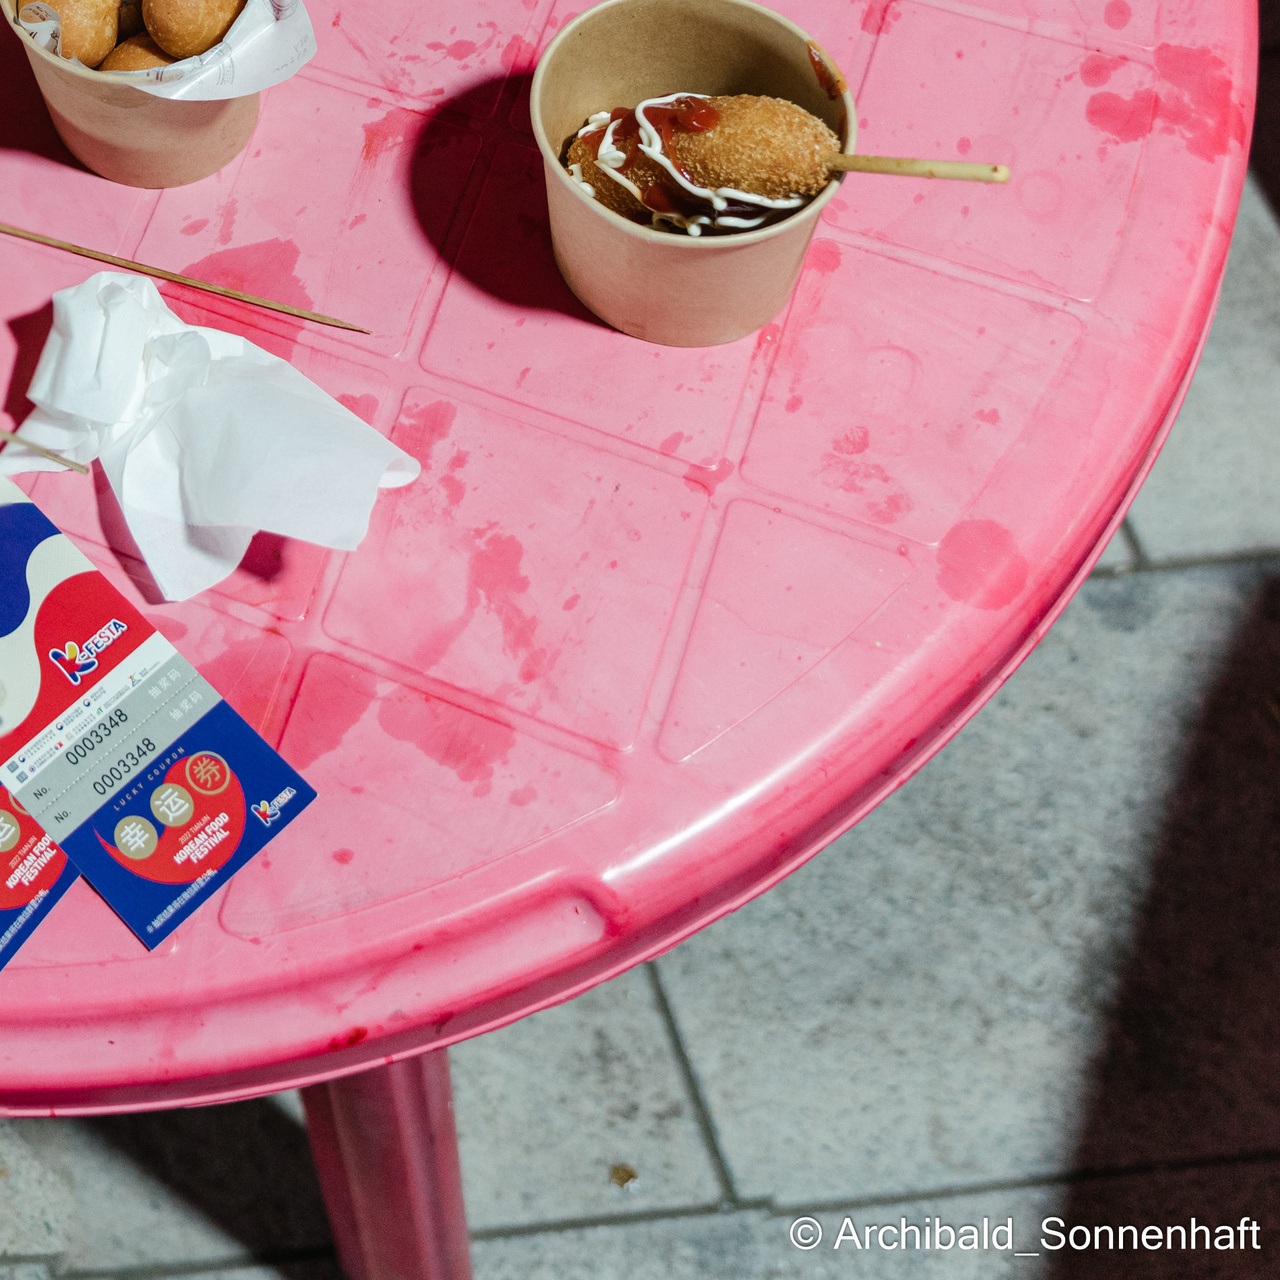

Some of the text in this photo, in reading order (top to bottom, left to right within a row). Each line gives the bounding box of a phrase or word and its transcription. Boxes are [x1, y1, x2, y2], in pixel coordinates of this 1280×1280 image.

[49, 619, 128, 686] K-FESTA
[32, 666, 181, 800] No. 0003348 抽奖码
[54, 688, 203, 823] No. 0003348 抽奖码
[113, 745, 185, 811] LUCKY COUPON
[117, 763, 220, 850] 幸运券
[178, 813, 210, 844] 2022 TIANJIN
[251, 787, 297, 827] K-FESTA
[8, 835, 37, 868] 2022 TIANJIN
[172, 811, 229, 864] KOREAN FOOD
[189, 825, 230, 863] FESTIVAL
[5, 852, 37, 888] KOREAN
[20, 845, 56, 885] FESTIVAL
